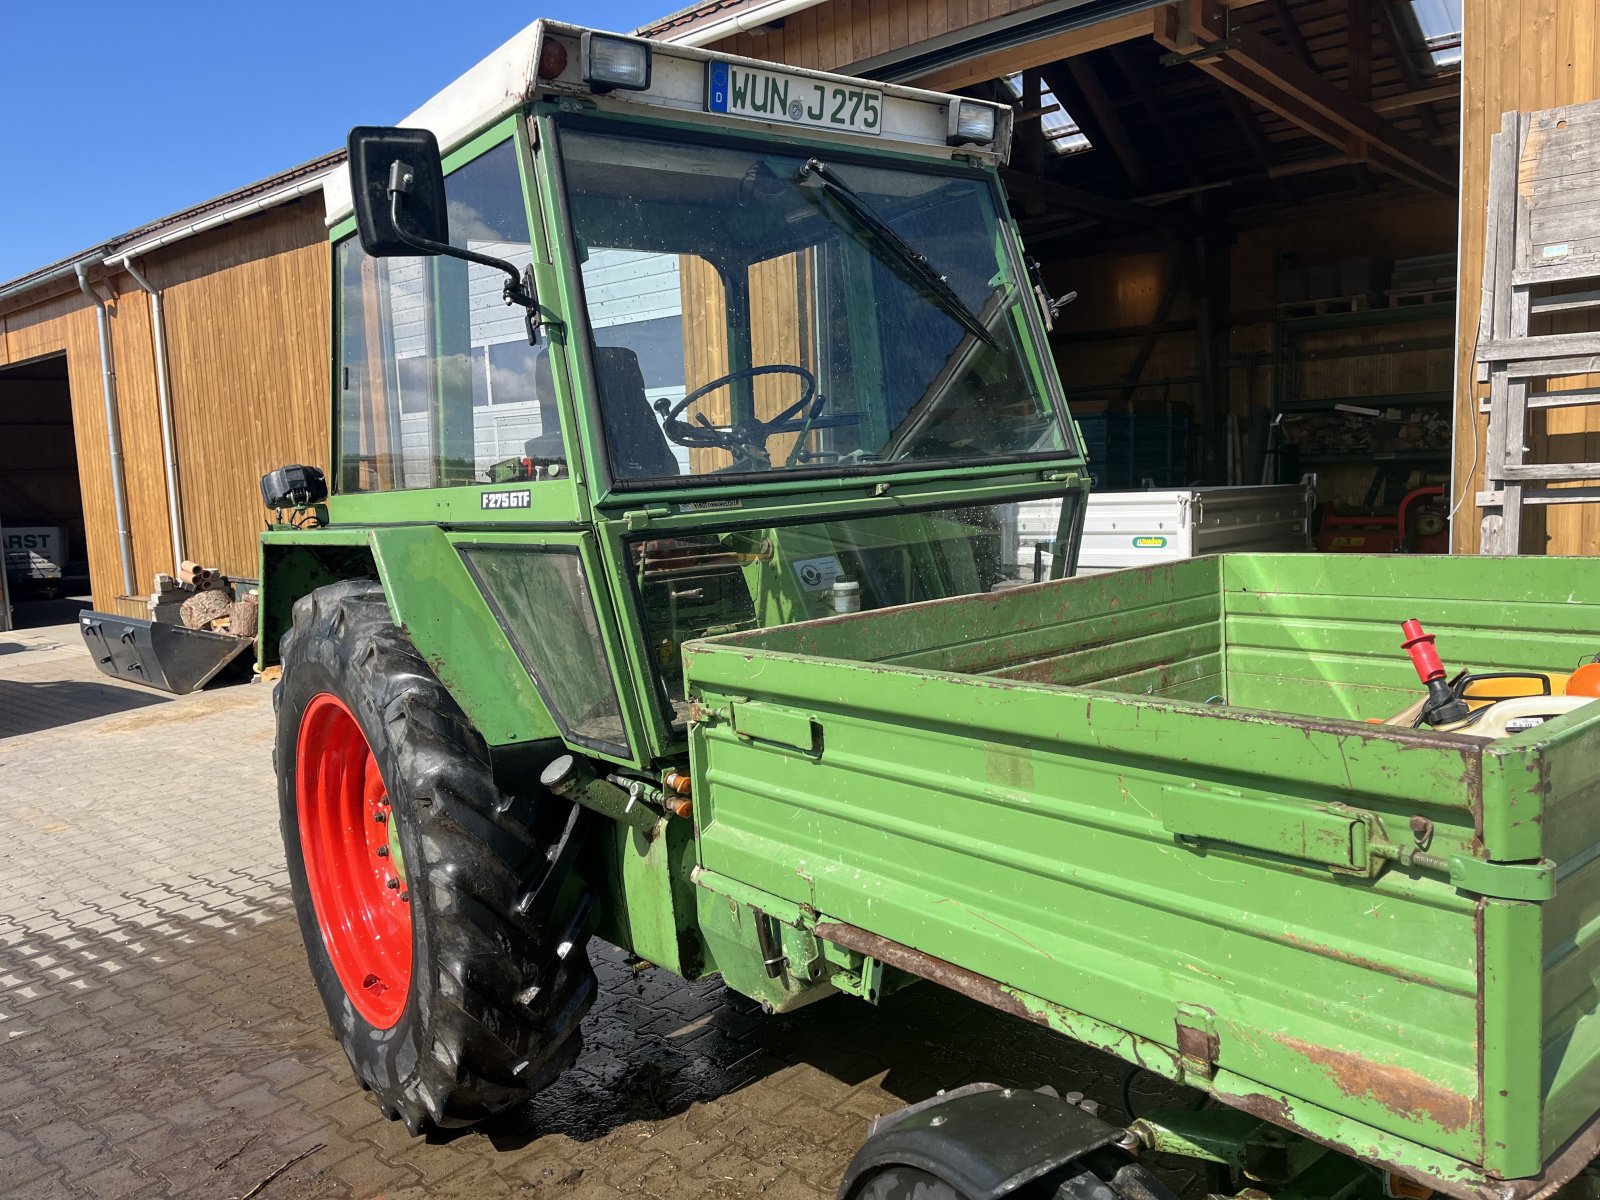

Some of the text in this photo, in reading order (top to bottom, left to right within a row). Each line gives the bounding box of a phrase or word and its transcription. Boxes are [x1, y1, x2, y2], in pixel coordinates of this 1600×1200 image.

[715, 91, 722, 103] D
[731, 70, 879, 128] WUN J 275
